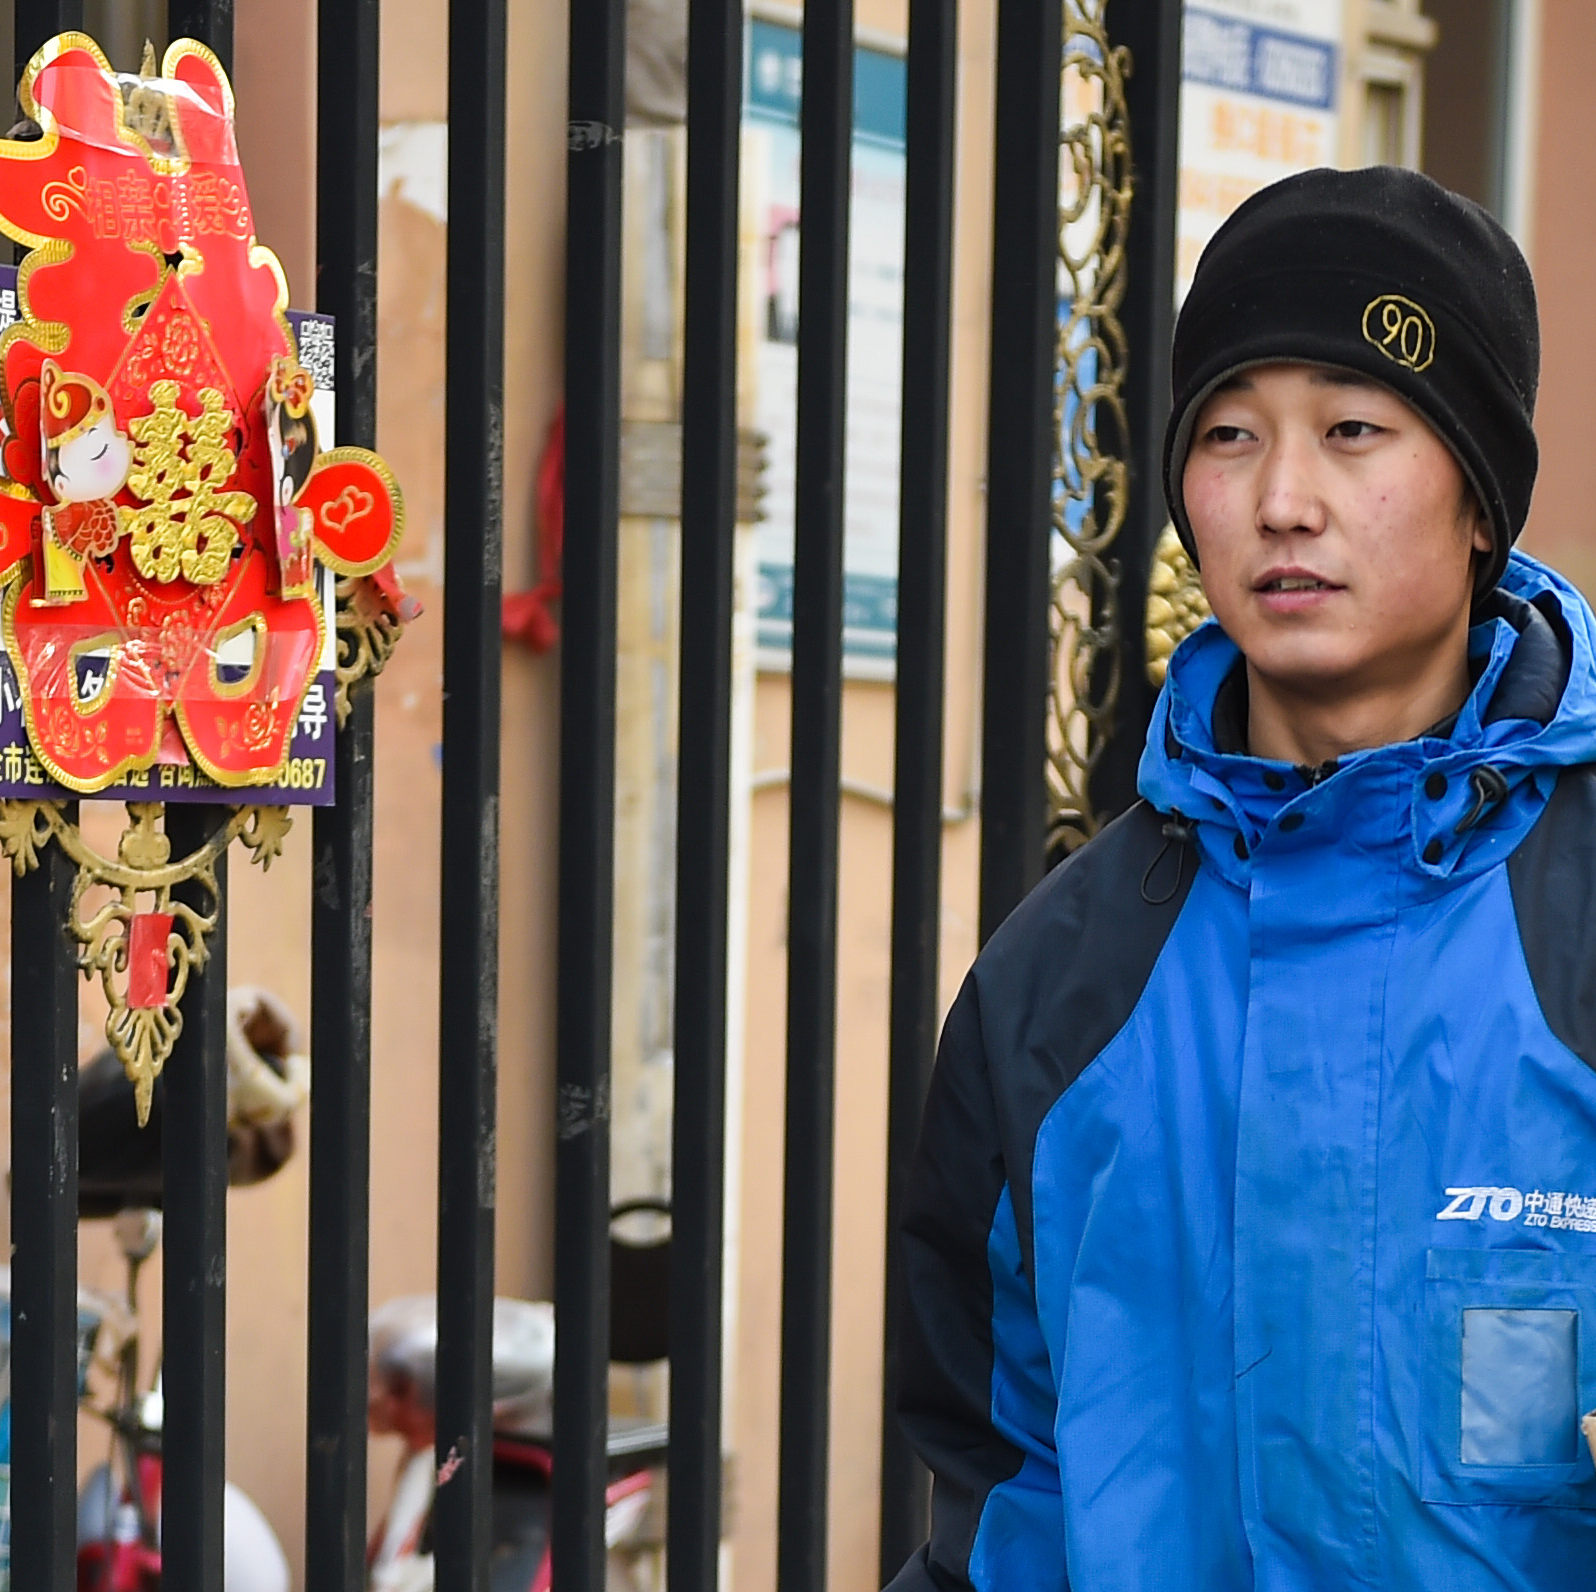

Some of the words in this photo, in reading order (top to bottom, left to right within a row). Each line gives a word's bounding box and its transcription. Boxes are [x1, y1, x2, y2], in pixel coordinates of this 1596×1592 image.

[1383, 303, 1422, 364] 90
[1436, 1187, 1523, 1222] ZTO
[1523, 1213, 1548, 1227] ZTO
